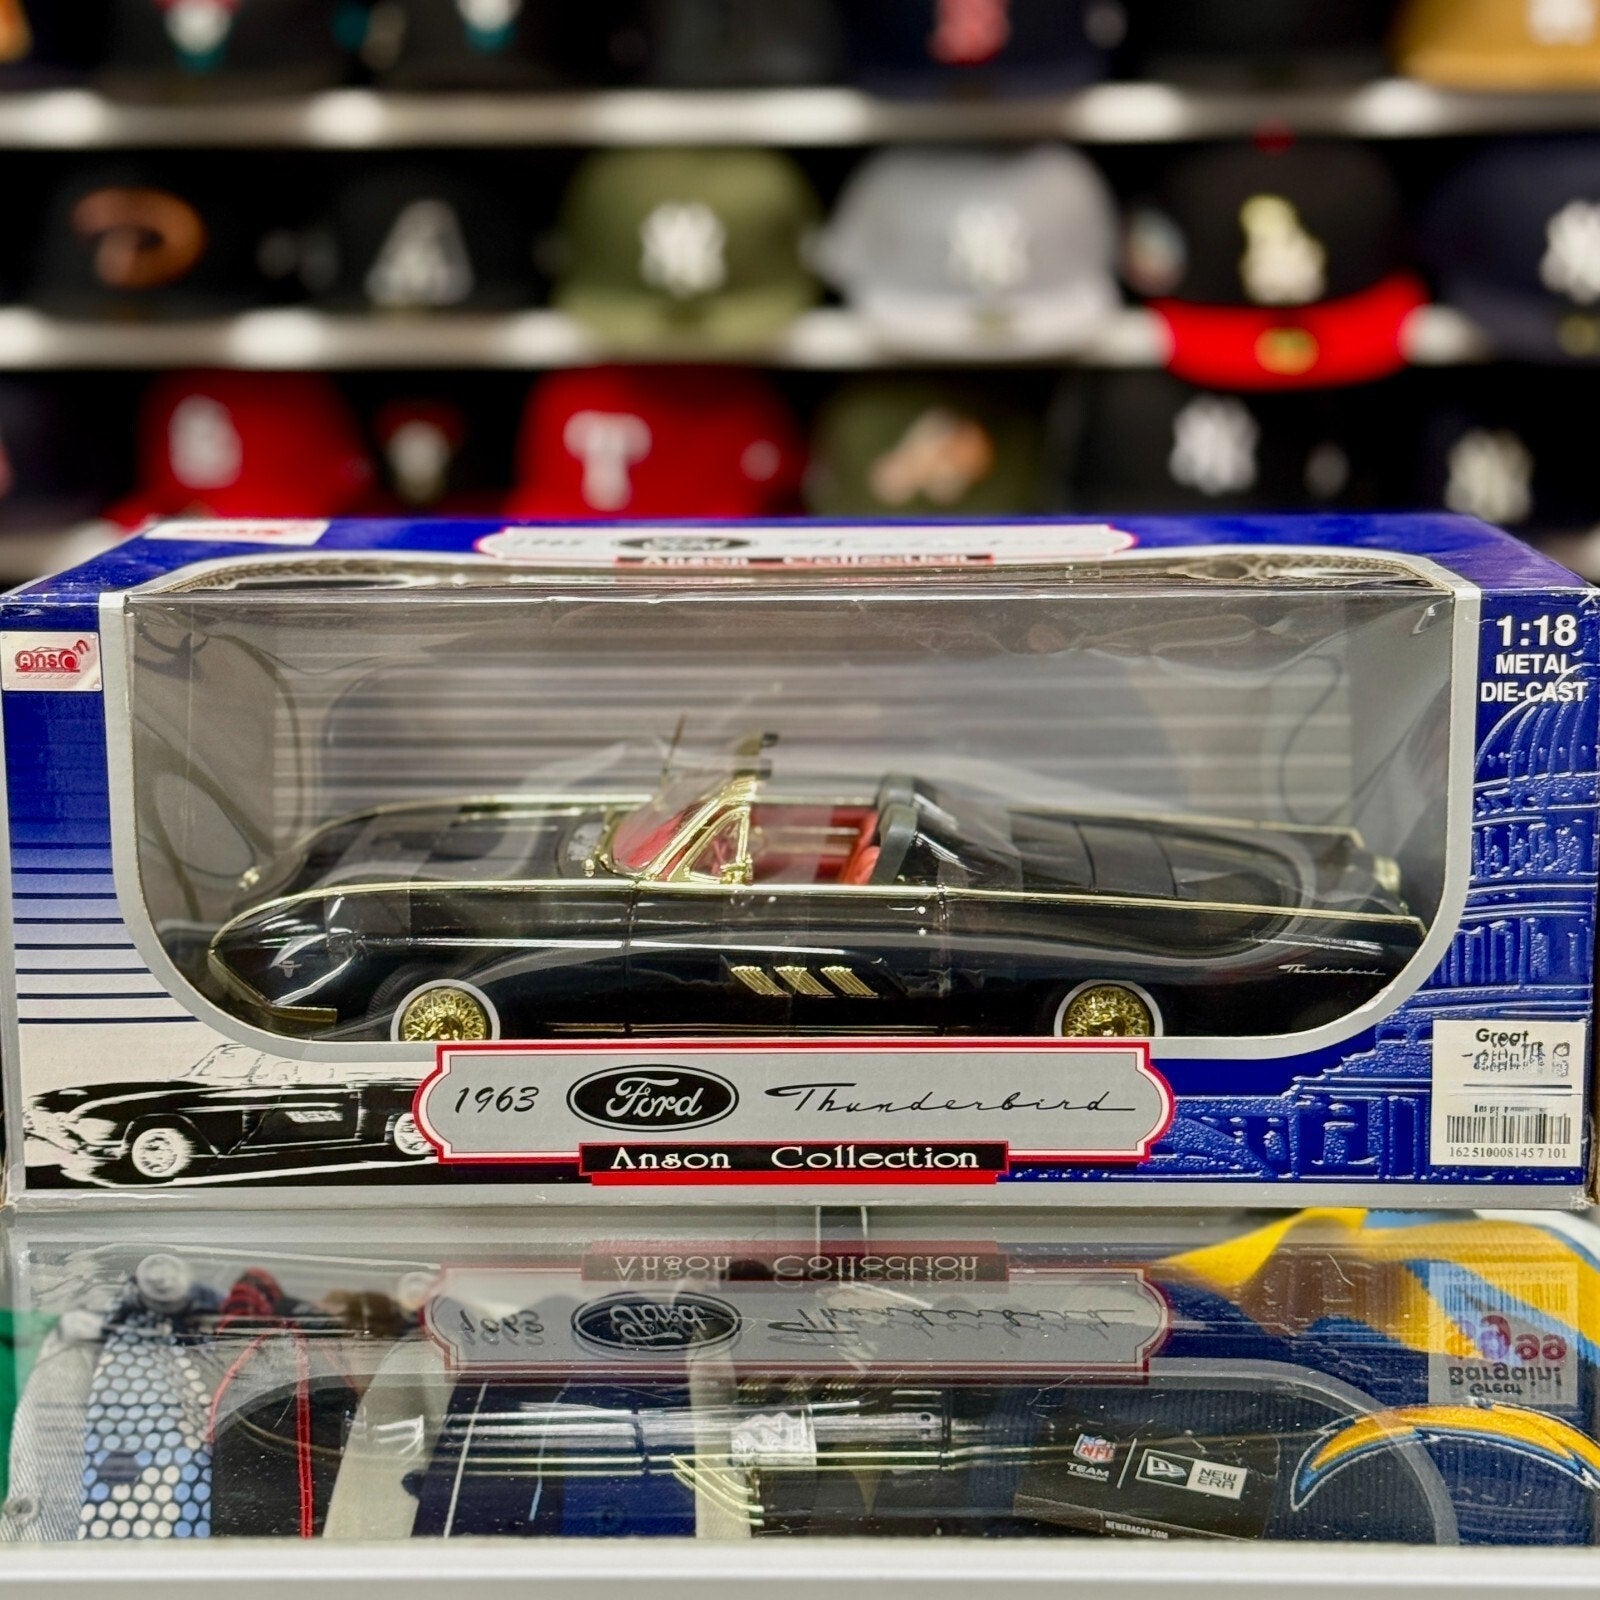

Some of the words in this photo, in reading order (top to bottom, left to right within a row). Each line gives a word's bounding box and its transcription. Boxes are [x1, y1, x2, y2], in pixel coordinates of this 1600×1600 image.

[1496, 614, 1577, 647] 1:18
[1495, 653, 1575, 674] METAL
[1480, 681, 1589, 702] DIE-CAST
[453, 1085, 540, 1114] 1963
[604, 1076, 705, 1118] Ford
[764, 1082, 1136, 1113] Thunderbird
[610, 1146, 732, 1170] Anson
[770, 1145, 980, 1170] Collection
[1197, 1475, 1235, 1491] ERA
[1199, 1467, 1238, 1482] NEW
